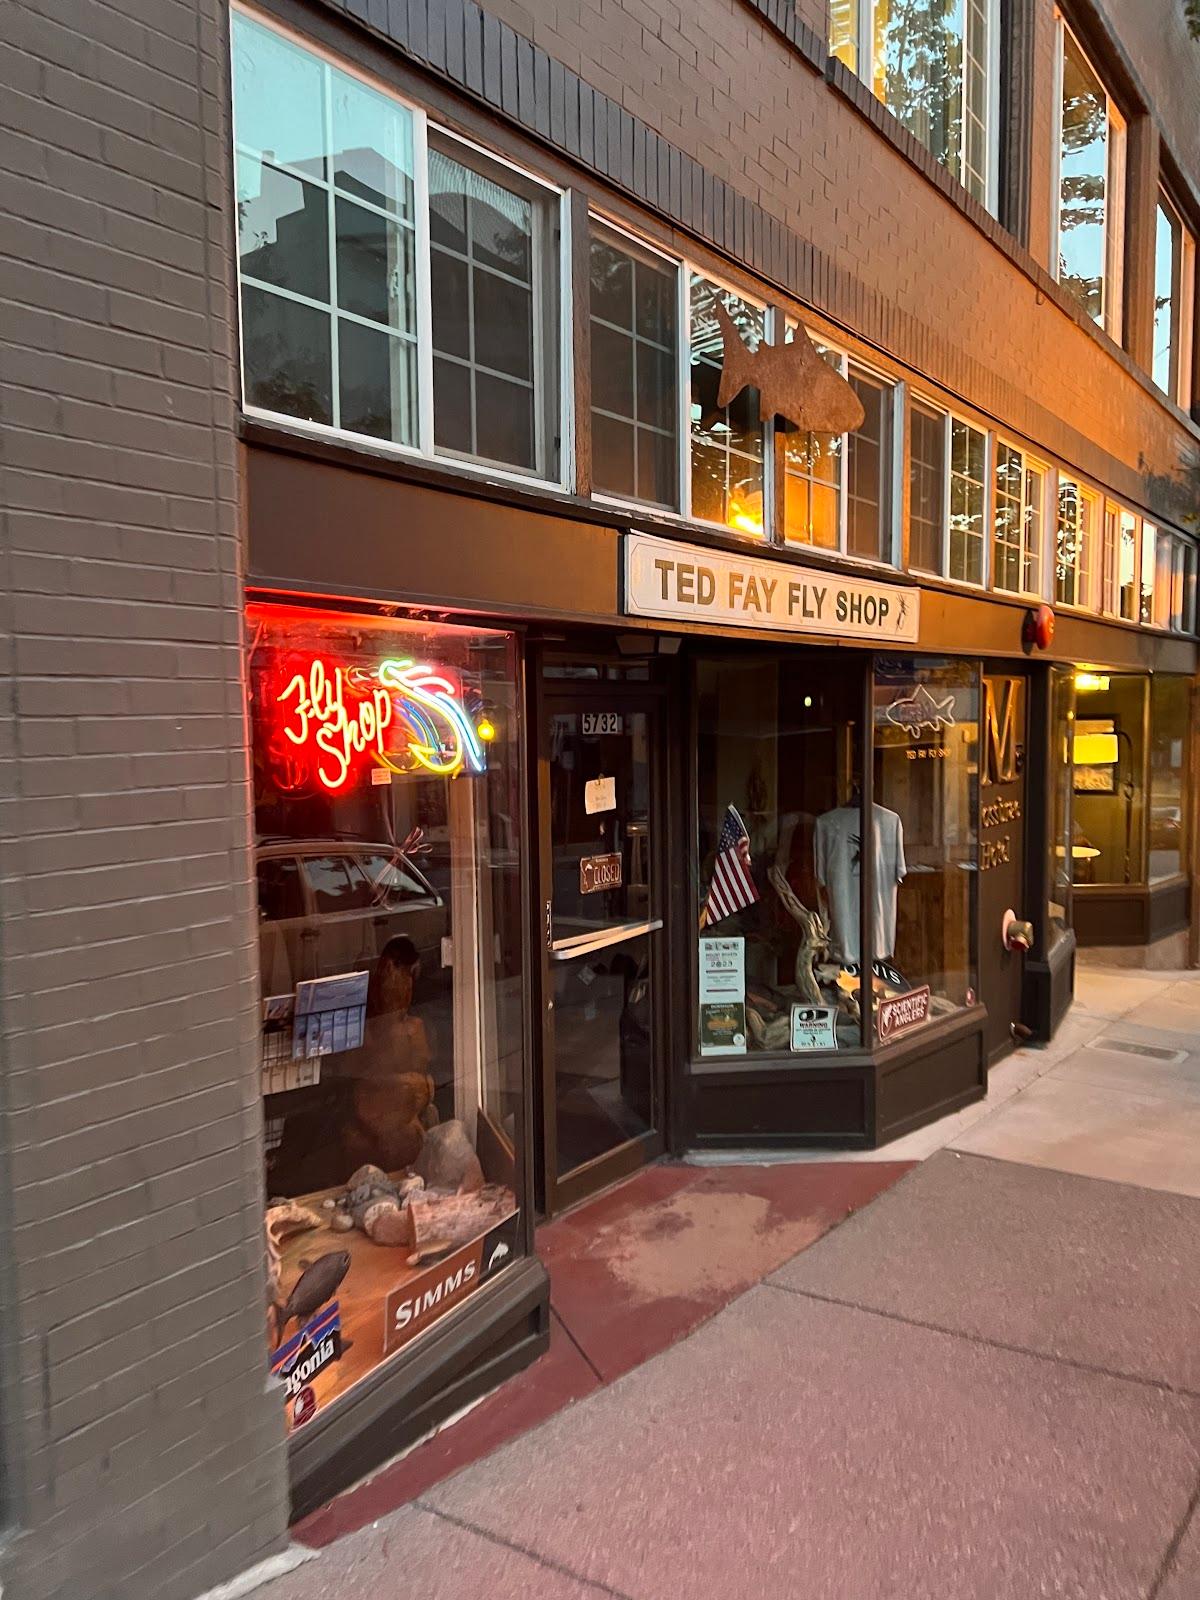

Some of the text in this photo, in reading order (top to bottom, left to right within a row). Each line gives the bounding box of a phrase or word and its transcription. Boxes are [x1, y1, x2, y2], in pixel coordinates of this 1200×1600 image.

[655, 559, 889, 627] TED FAY FLY SHOP
[276, 659, 344, 745] Fly
[584, 714, 616, 733] 5732
[981, 678, 1022, 786] M
[315, 688, 392, 788] Shop
[593, 863, 620, 885] CLOSED
[844, 962, 901, 985] OVIS
[395, 1260, 477, 1330] SIMMS
